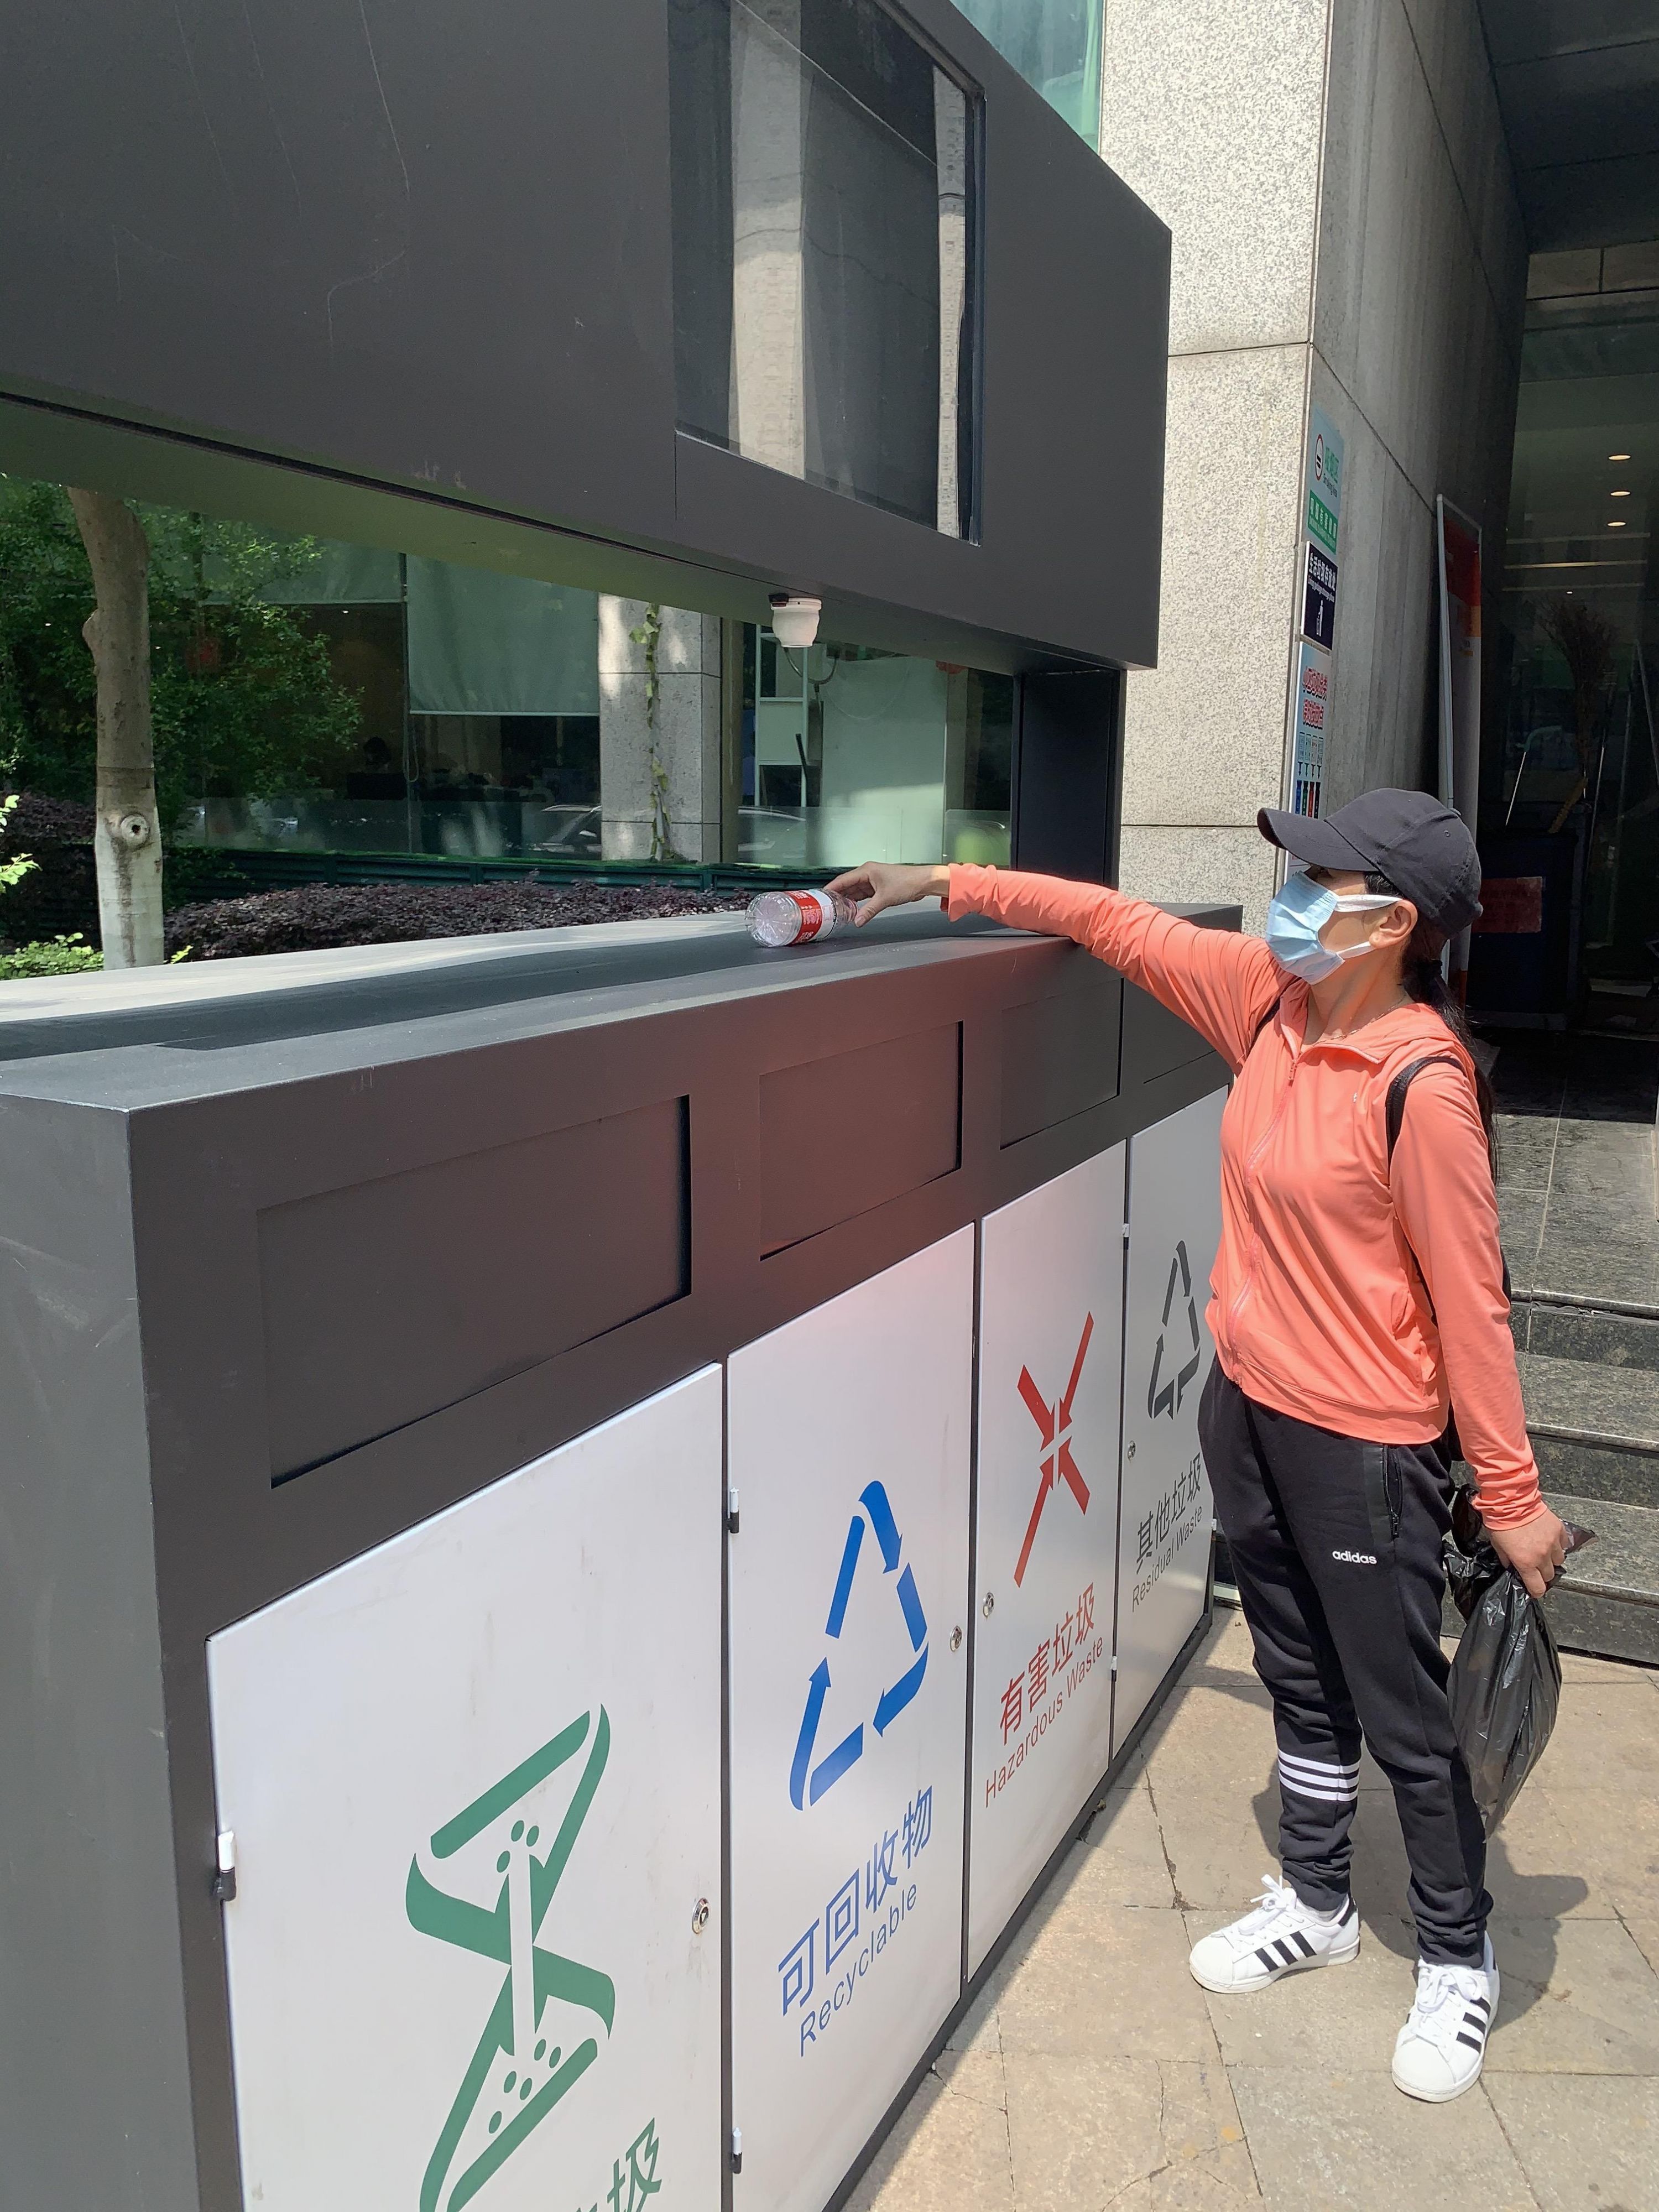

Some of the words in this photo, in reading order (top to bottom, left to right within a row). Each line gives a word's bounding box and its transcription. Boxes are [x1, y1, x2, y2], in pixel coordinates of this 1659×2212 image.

[1132, 1538, 1175, 1613] Residual
[1176, 1506, 1202, 1552] Waste
[1136, 1452, 1201, 1575] 其他垃圾
[1332, 1550, 1378, 1564] adidas
[985, 1692, 1063, 1808] Hazardous
[1066, 1636, 1103, 1699] Waste
[1000, 1582, 1094, 1746] 有害垃圾
[778, 1785, 933, 2017] 可回收物
[800, 1883, 918, 2058] Recyclable
